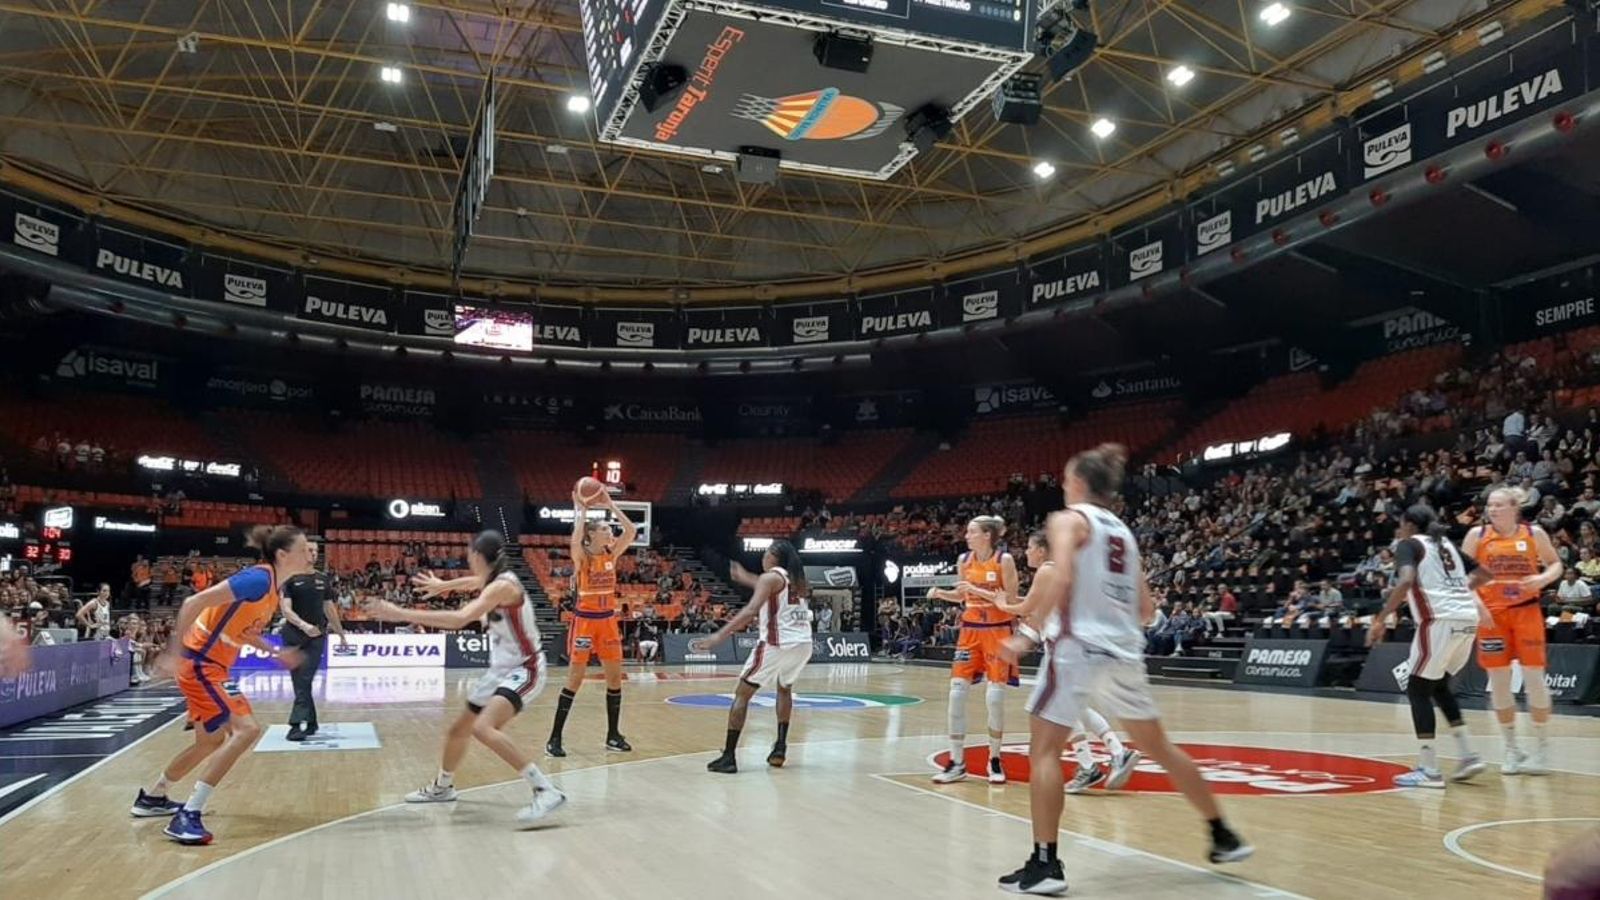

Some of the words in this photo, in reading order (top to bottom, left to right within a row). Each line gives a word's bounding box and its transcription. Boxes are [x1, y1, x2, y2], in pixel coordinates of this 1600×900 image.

[1447, 68, 1563, 138] PULEVA
[1367, 130, 1408, 156] PULEVA
[1255, 171, 1336, 225] PULEVA
[18, 217, 56, 239] PULEVA
[1200, 216, 1229, 236] PULEVA
[1131, 246, 1162, 263] PULEVA
[97, 249, 183, 289] PULEVA
[227, 276, 265, 292] PULEVA
[1032, 271, 1100, 303] PULEVA
[305, 296, 388, 326] PULEVA
[965, 294, 997, 307] PULEVA
[862, 310, 932, 334] PULEVA
[1535, 297, 1596, 328] SEMPRE
[532, 324, 581, 342] LEVA
[619, 325, 653, 334] PULEVA
[687, 326, 761, 344] PULEVA
[795, 319, 827, 330] PULEVA
[1384, 313, 1448, 338] PAM
[88, 352, 158, 380] isaval
[360, 384, 436, 405] PAMESA
[26, 545, 39, 557] 32
[59, 549, 71, 560] 30
[1108, 536, 1126, 573] 2
[362, 644, 440, 656] PULEVA
[826, 636, 869, 657] Solera
[1247, 648, 1312, 666] PAMESA
[16, 670, 56, 700] PULEVA
[1544, 673, 1577, 688] bitat
